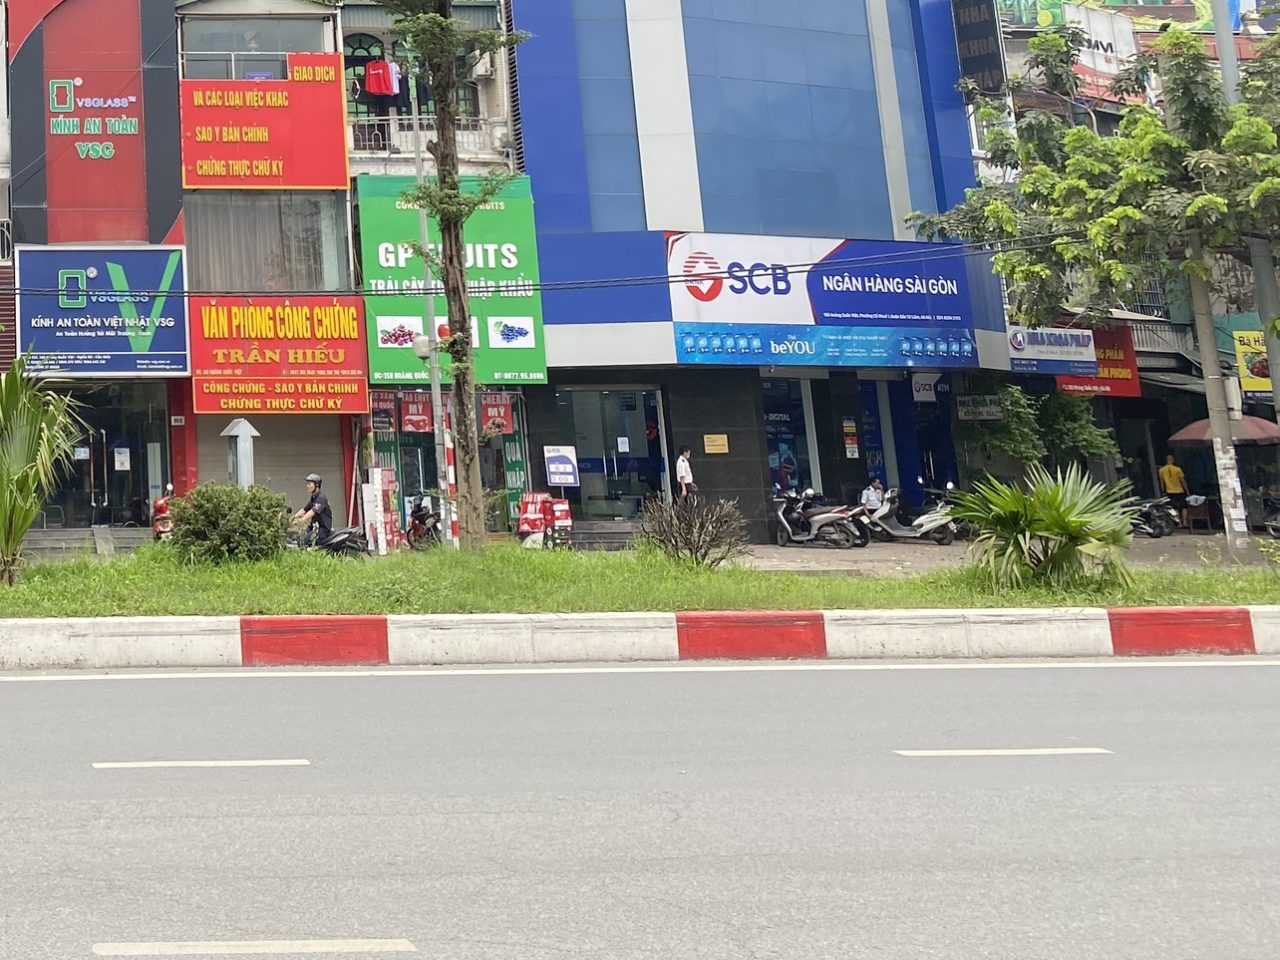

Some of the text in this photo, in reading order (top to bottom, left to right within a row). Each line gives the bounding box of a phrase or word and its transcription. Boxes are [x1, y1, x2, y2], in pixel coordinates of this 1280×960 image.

[293, 66, 335, 83] GIAO DỊCH
[193, 89, 288, 109] VÀ CÁC LOẠI VIỆC KHÁC
[50, 114, 138, 134] KÍNH AN TOÀN
[195, 121, 269, 143] SAO Y BẢN CHÍNH
[75, 142, 115, 159] VSG
[196, 156, 226, 176] CHỨNG
[228, 159, 251, 179] THỰC
[427, 243, 519, 269] UITS
[727, 262, 792, 296] SCB
[823, 272, 958, 296] NGÂN HÀNG SÀI GÒN
[31, 314, 175, 330] KÍNH AN TOÀN VIỆT NHẬT VSG
[201, 297, 359, 340] VĂN PHÒNG CÔNG CHỨNG
[213, 342, 346, 364] TRẦN HIẾU
[770, 340, 815, 355] beYOU
[203, 379, 358, 394] CÔNG CHỨNG SAO Y BẢN CHÍNH
[220, 395, 261, 409] CHỨNG
[265, 398, 296, 410] THỰC
